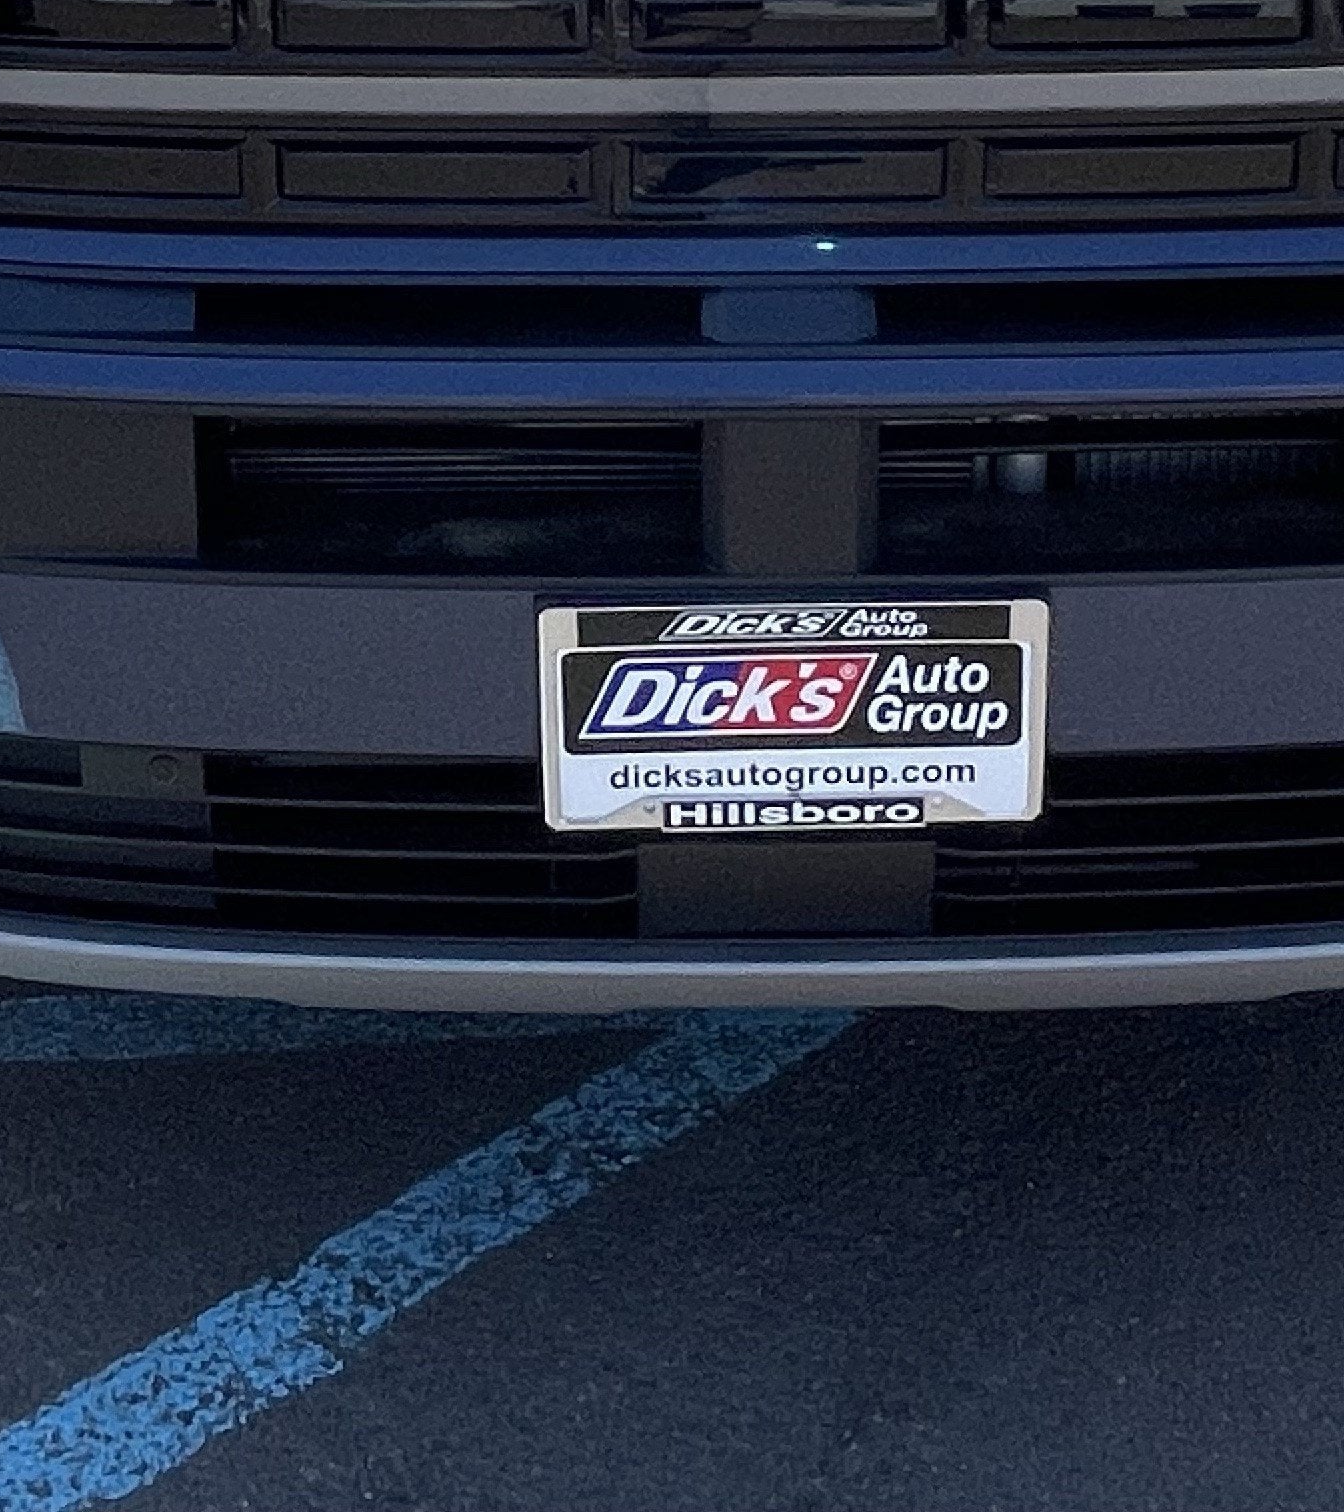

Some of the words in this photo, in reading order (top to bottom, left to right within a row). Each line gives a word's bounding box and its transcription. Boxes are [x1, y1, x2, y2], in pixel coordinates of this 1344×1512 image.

[840, 622, 928, 638] Group
[847, 608, 918, 624] Auto
[875, 653, 990, 694] Auto
[599, 661, 840, 728] Dick's
[866, 698, 1009, 739] Group
[609, 761, 977, 792] dicksautogroup.com
[668, 799, 921, 827] Hillsboro
